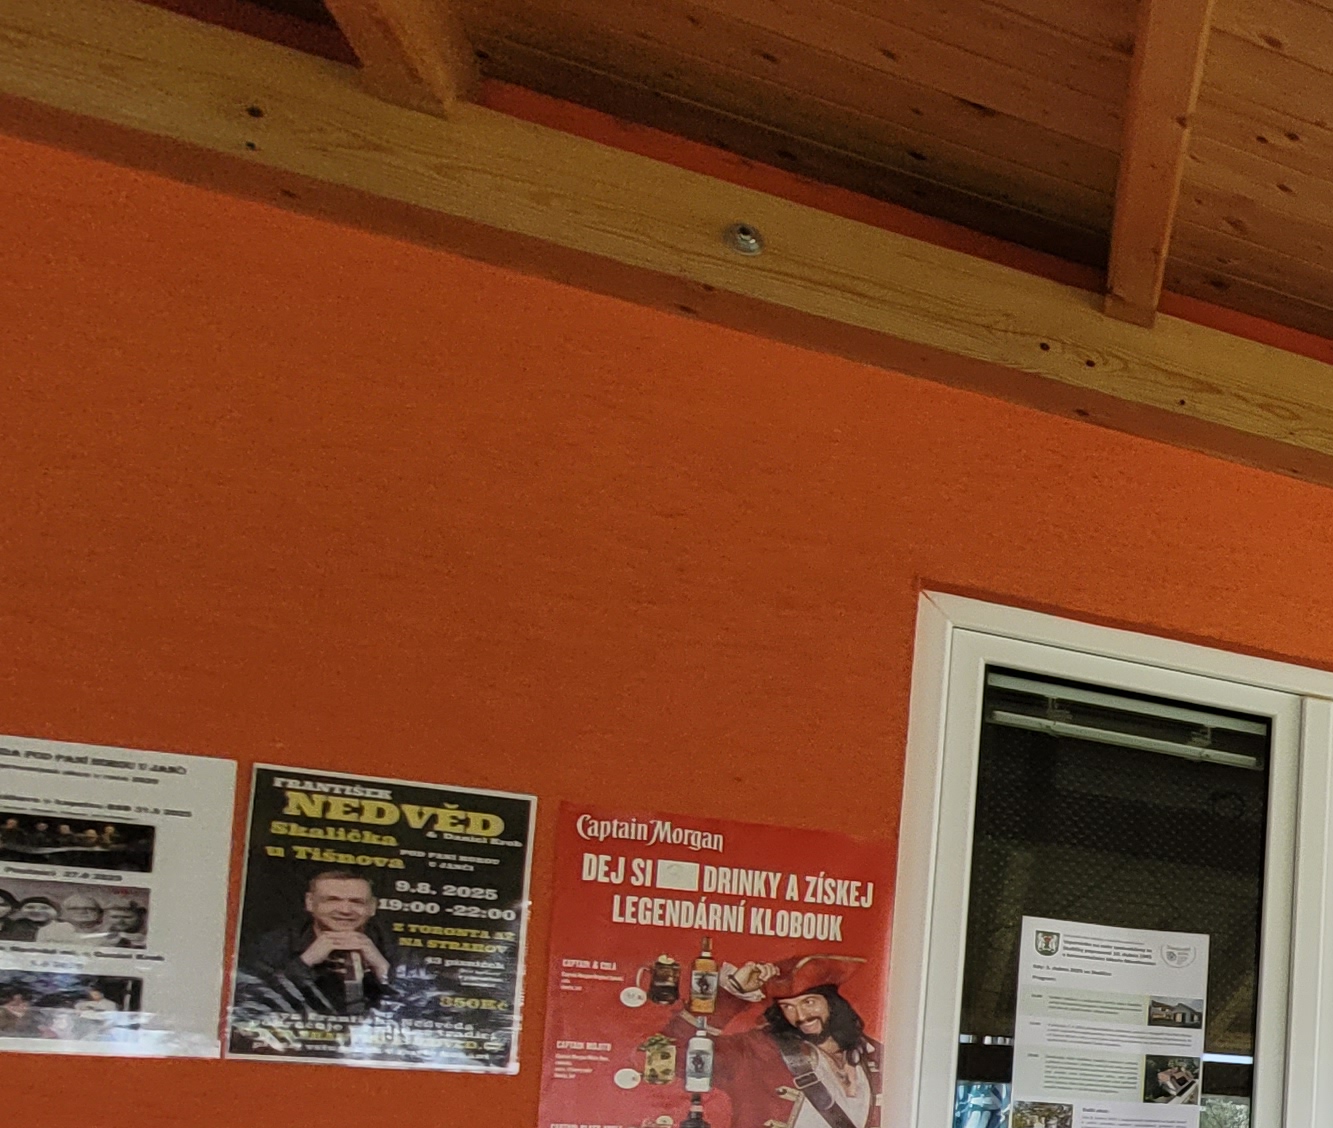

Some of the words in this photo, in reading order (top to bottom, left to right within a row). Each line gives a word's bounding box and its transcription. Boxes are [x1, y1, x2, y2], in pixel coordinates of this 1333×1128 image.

[272, 777, 393, 800] FRANTIŠEK
[282, 790, 505, 837] NEDVĚD
[270, 820, 399, 847] Skalička
[576, 814, 648, 842] Captain
[647, 820, 724, 853] Morgan
[264, 845, 285, 857] u
[291, 845, 406, 869] Tišnova
[395, 880, 437, 895] 9.8.
[442, 884, 499, 900] 2025
[581, 852, 626, 885] DEJ
[630, 858, 653, 887] SI
[703, 865, 783, 899] DRINKY
[785, 874, 799, 901] A
[803, 871, 874, 908] ZÍSKEJ
[378, 898, 440, 914] 19:00
[445, 905, 517, 921] -22:00
[612, 894, 746, 933] LEGENDÁRNÍ
[749, 907, 843, 942] KLOBOUK
[398, 937, 424, 947] NA
[407, 924, 491, 939] TORONTA
